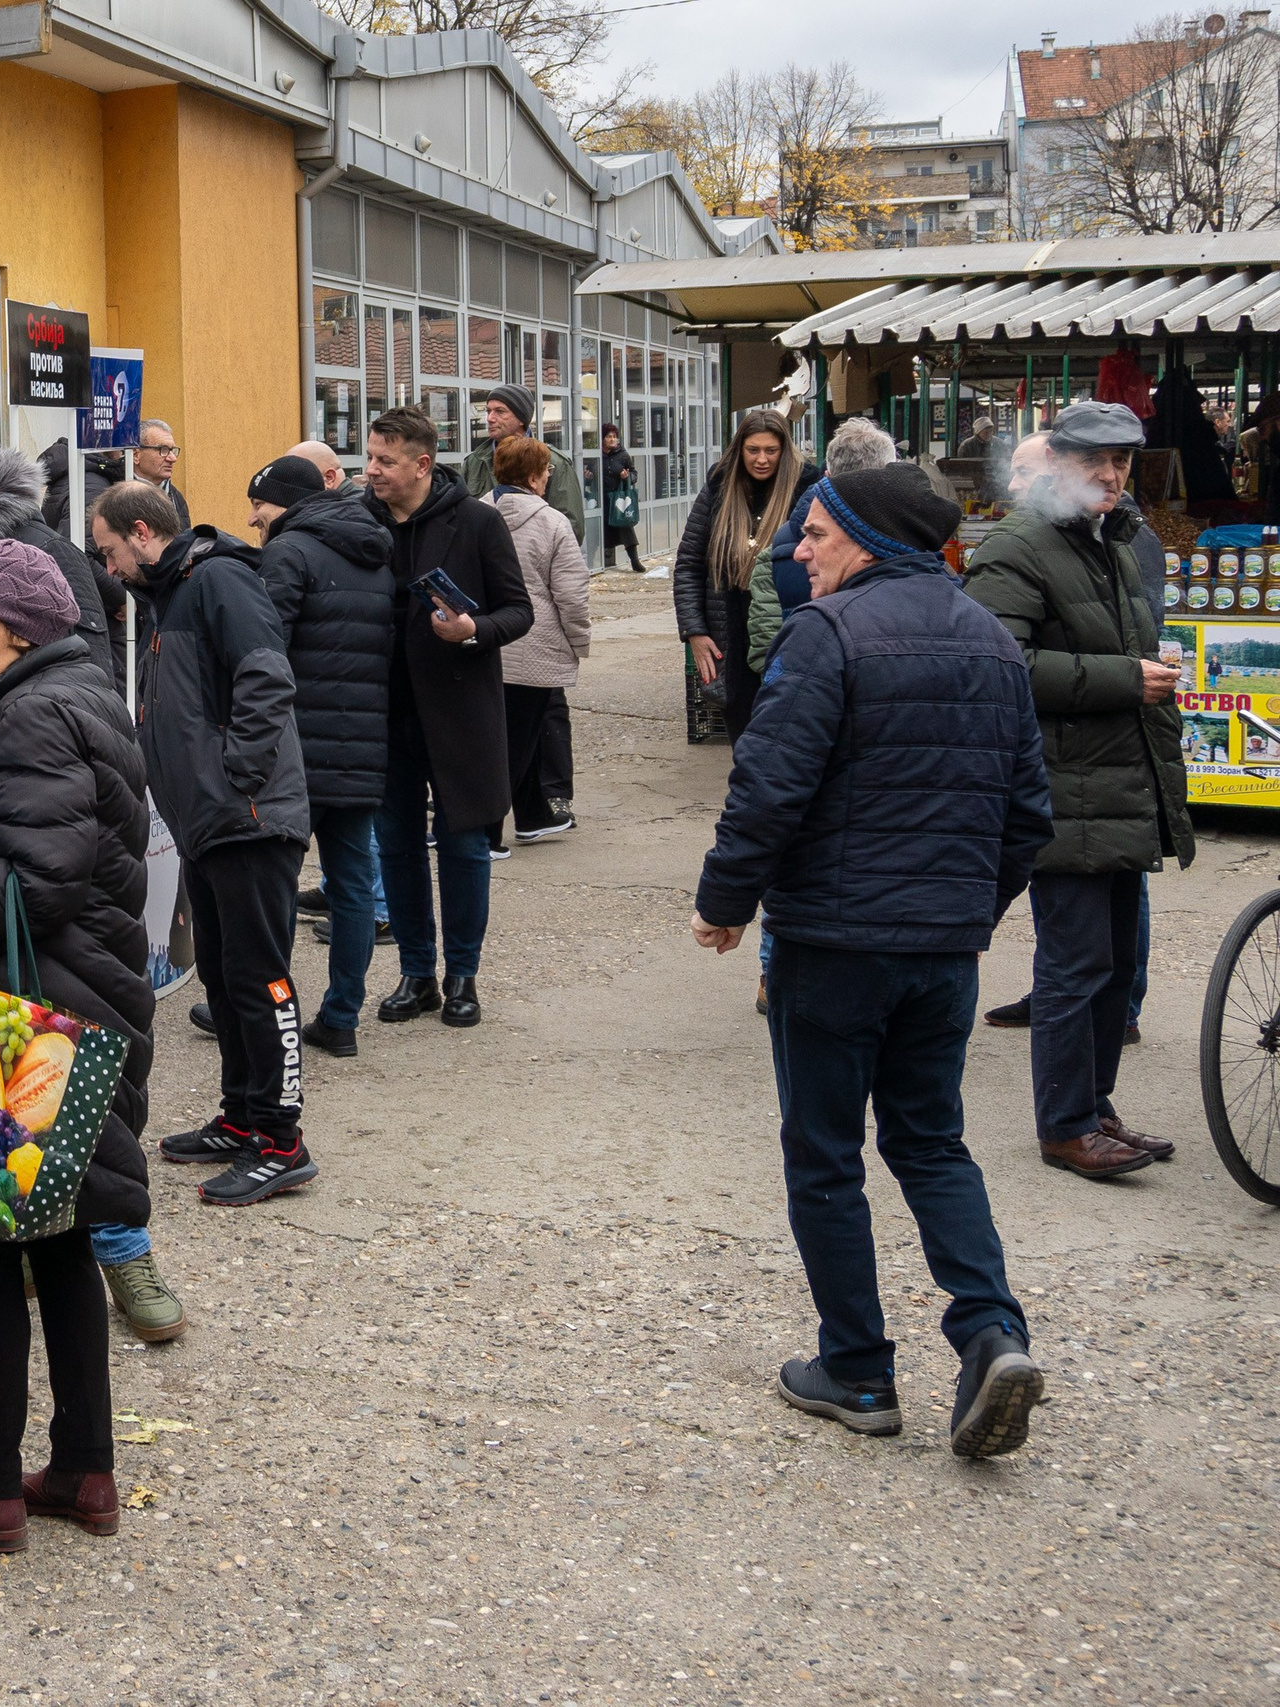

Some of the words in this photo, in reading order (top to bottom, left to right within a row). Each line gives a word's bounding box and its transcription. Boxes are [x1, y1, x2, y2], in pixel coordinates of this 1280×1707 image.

[27, 312, 64, 350] Србија
[30, 352, 63, 377] против
[30, 380, 64, 399] насиља
[94, 396, 113, 407] СРБИЈА
[94, 407, 113, 418] ПРОТИВ
[275, 1002, 297, 1030] IT.
[281, 1030, 300, 1067] DO
[279, 1066, 302, 1108] JUST
